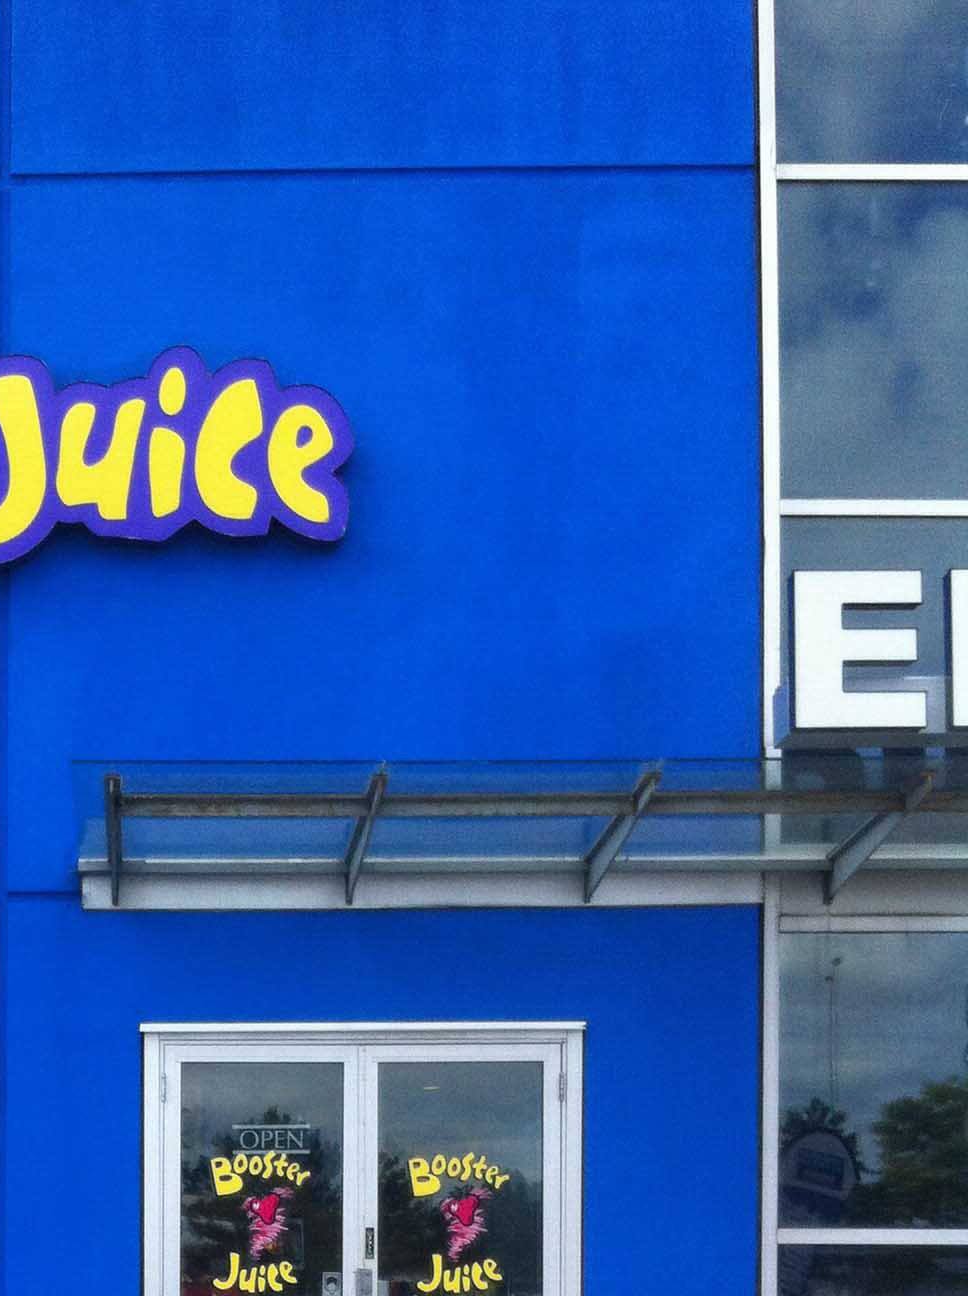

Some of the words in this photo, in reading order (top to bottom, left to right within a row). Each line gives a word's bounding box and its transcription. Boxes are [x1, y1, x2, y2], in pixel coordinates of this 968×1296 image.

[240, 1130, 303, 1149] OPEN
[211, 1150, 311, 1196] Booster
[408, 1152, 510, 1197] Booster
[213, 1252, 297, 1293] Juice
[417, 1254, 503, 1293] Juice
